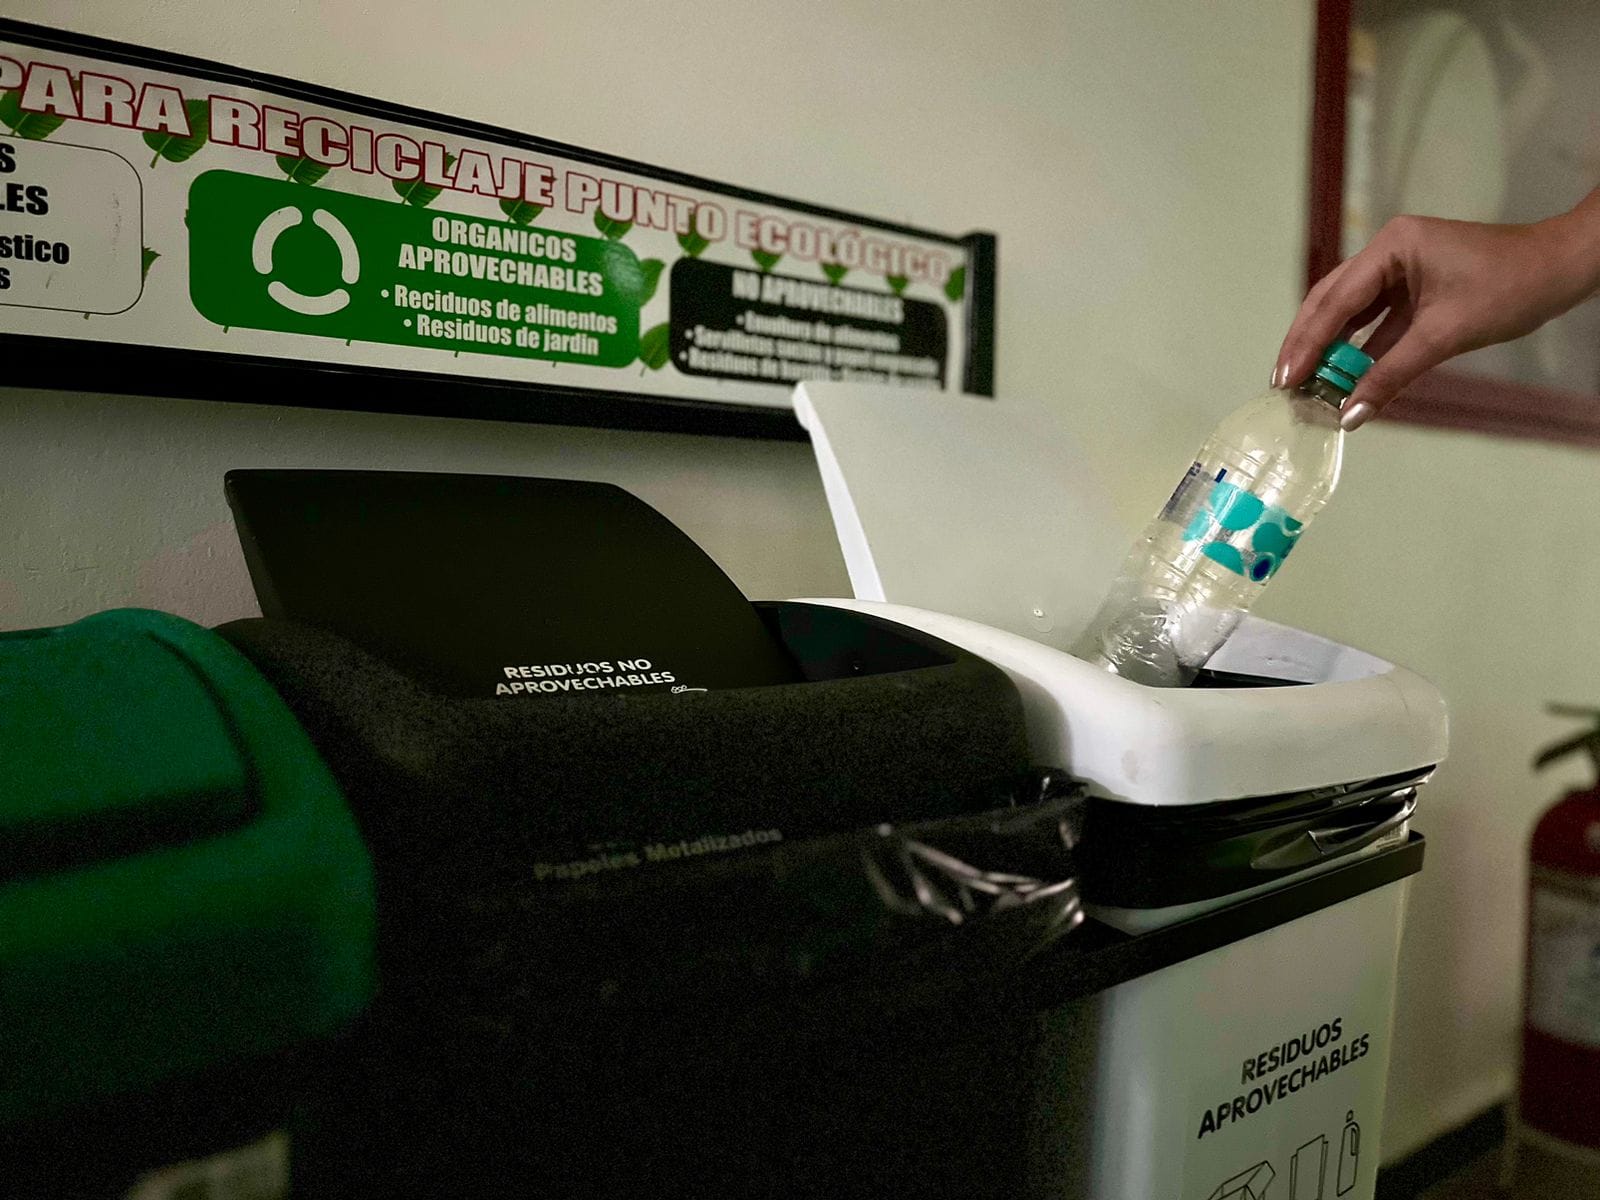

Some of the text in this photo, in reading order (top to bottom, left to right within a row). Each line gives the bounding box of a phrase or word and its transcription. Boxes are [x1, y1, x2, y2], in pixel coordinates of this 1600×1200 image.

[208, 95, 554, 207] RECICLAJE
[566, 171, 727, 242] PUNTO
[735, 210, 950, 286] ECOLÓGICO
[432, 216, 577, 263] ORGANICOS
[398, 243, 604, 296] APROVECHABLES
[394, 284, 618, 334] Reciduos de alimentos
[417, 314, 599, 356] Residuos de jardin
[496, 671, 676, 695] APROVECHABLES
[503, 658, 652, 679] RESIDUOS NO
[644, 828, 783, 863] Metalizados
[1241, 1017, 1342, 1085] RESIDUOS
[1198, 1033, 1370, 1139] APROVECHABLES
